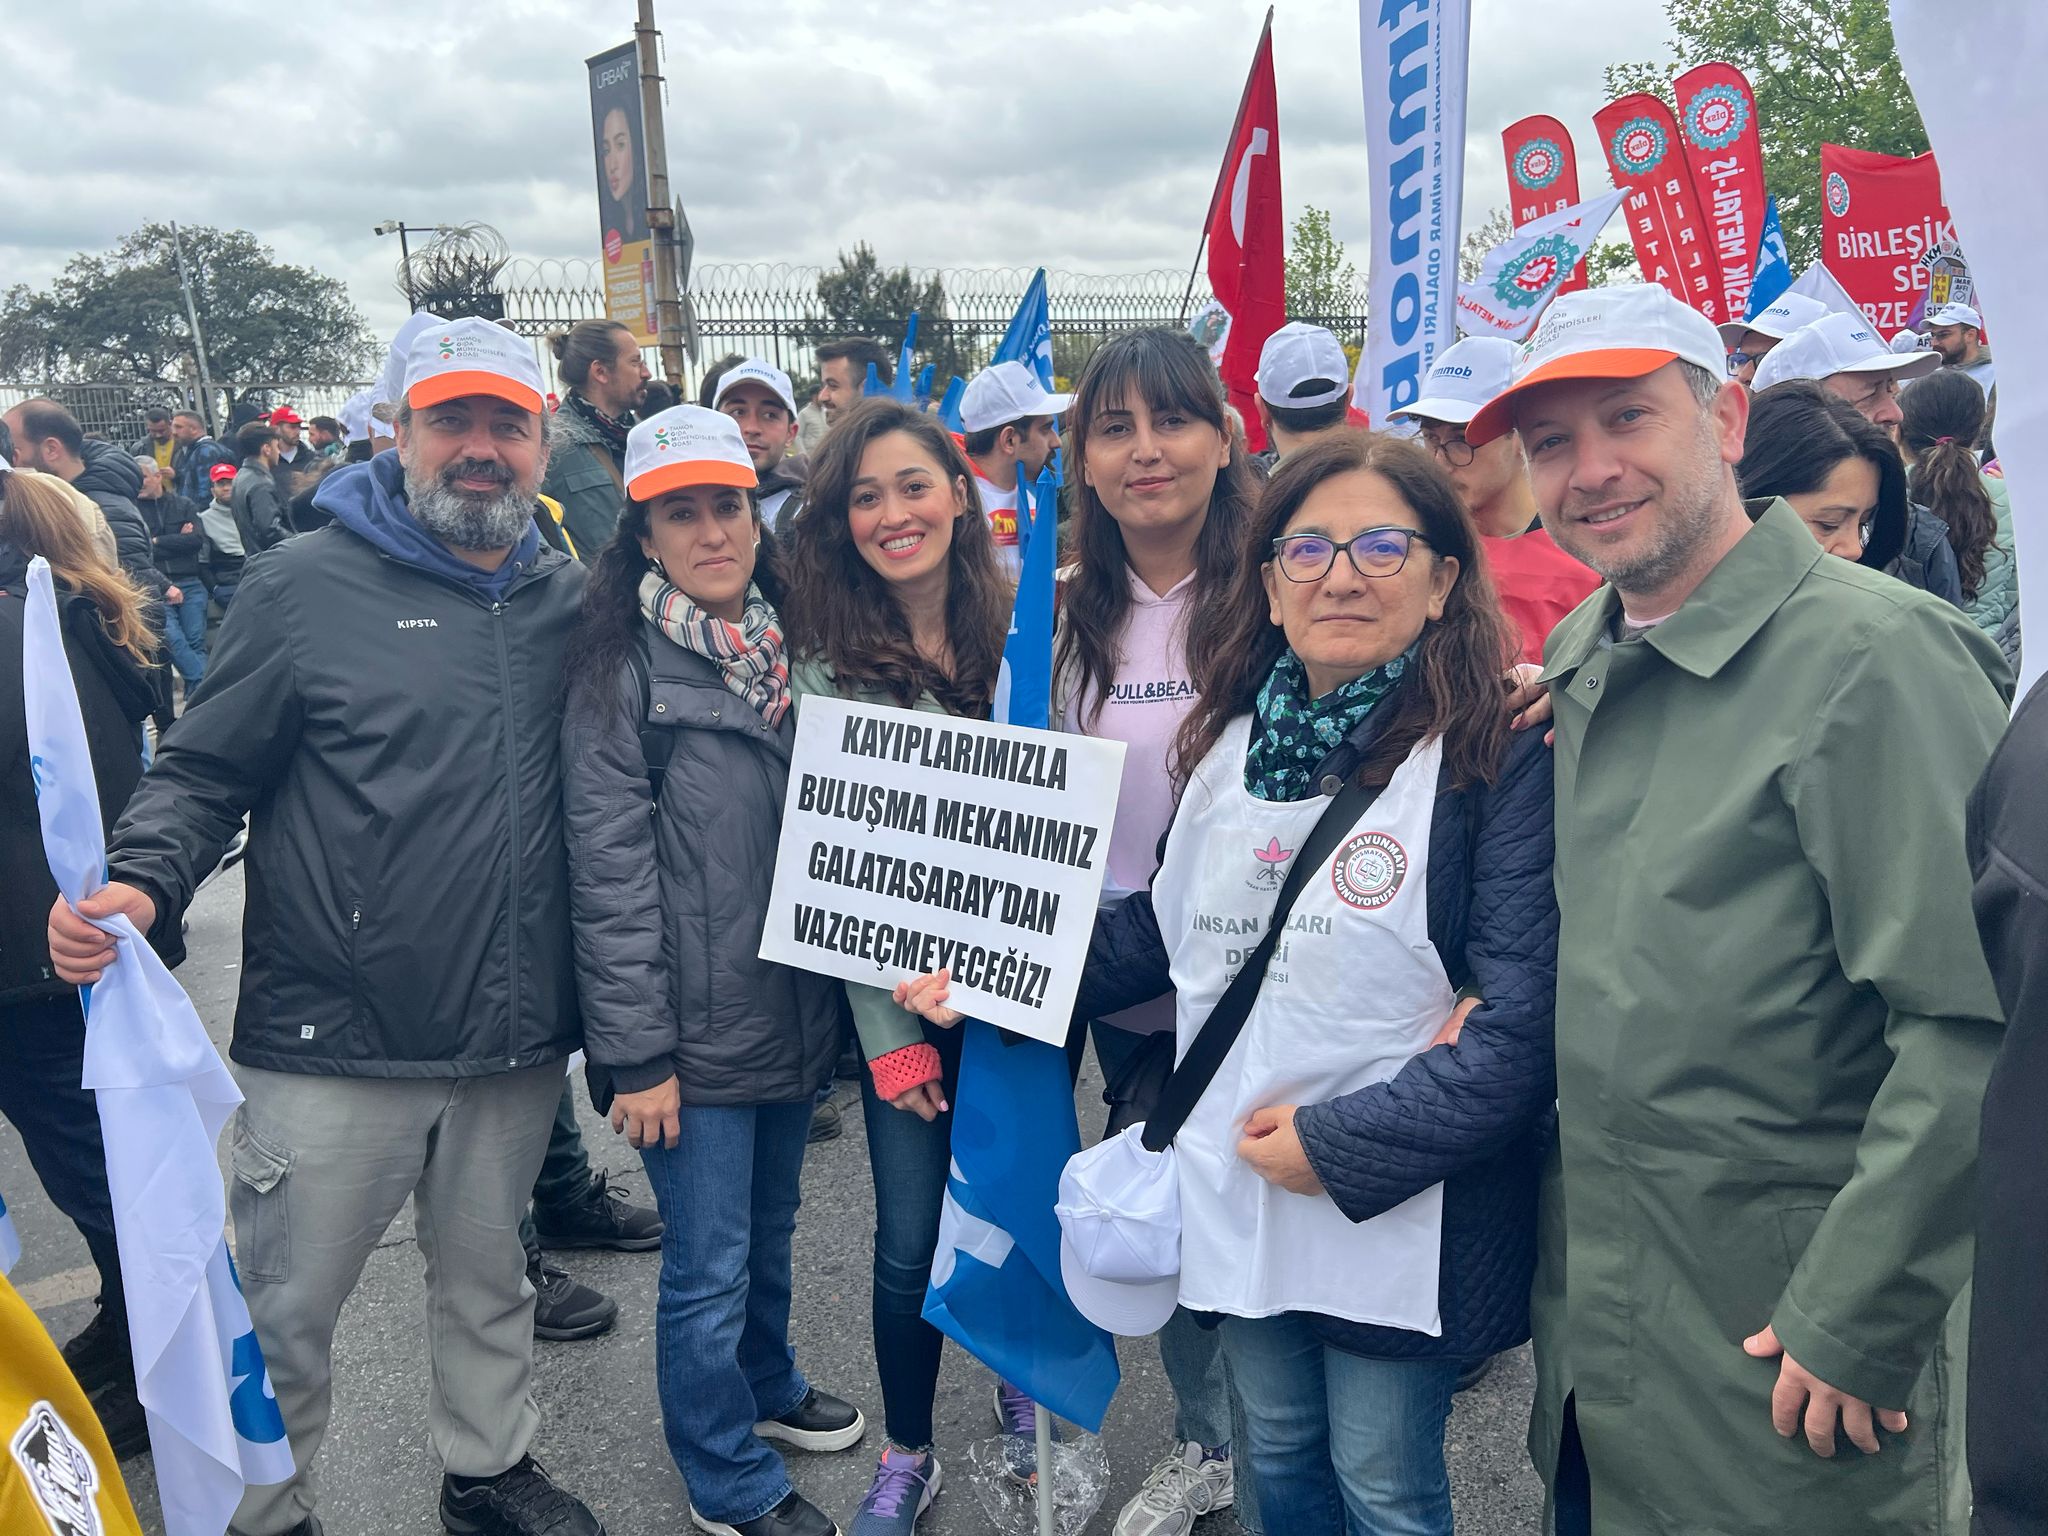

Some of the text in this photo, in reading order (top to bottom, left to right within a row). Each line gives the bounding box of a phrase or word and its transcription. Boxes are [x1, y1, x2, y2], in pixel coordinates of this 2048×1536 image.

[1837, 215, 1956, 260] BİRLEŞİK
[396, 618, 438, 629] KIPSTA
[840, 714, 1068, 791] KAYIPLARIMIZLA
[797, 773, 1099, 870] BULUŞMA MEKANIMIZ
[1349, 835, 1406, 874] SAVUNMAYI
[1193, 909, 1259, 935] İNSAN
[793, 902, 1052, 1010] VAZGEÇMEYECEĞİZ!
